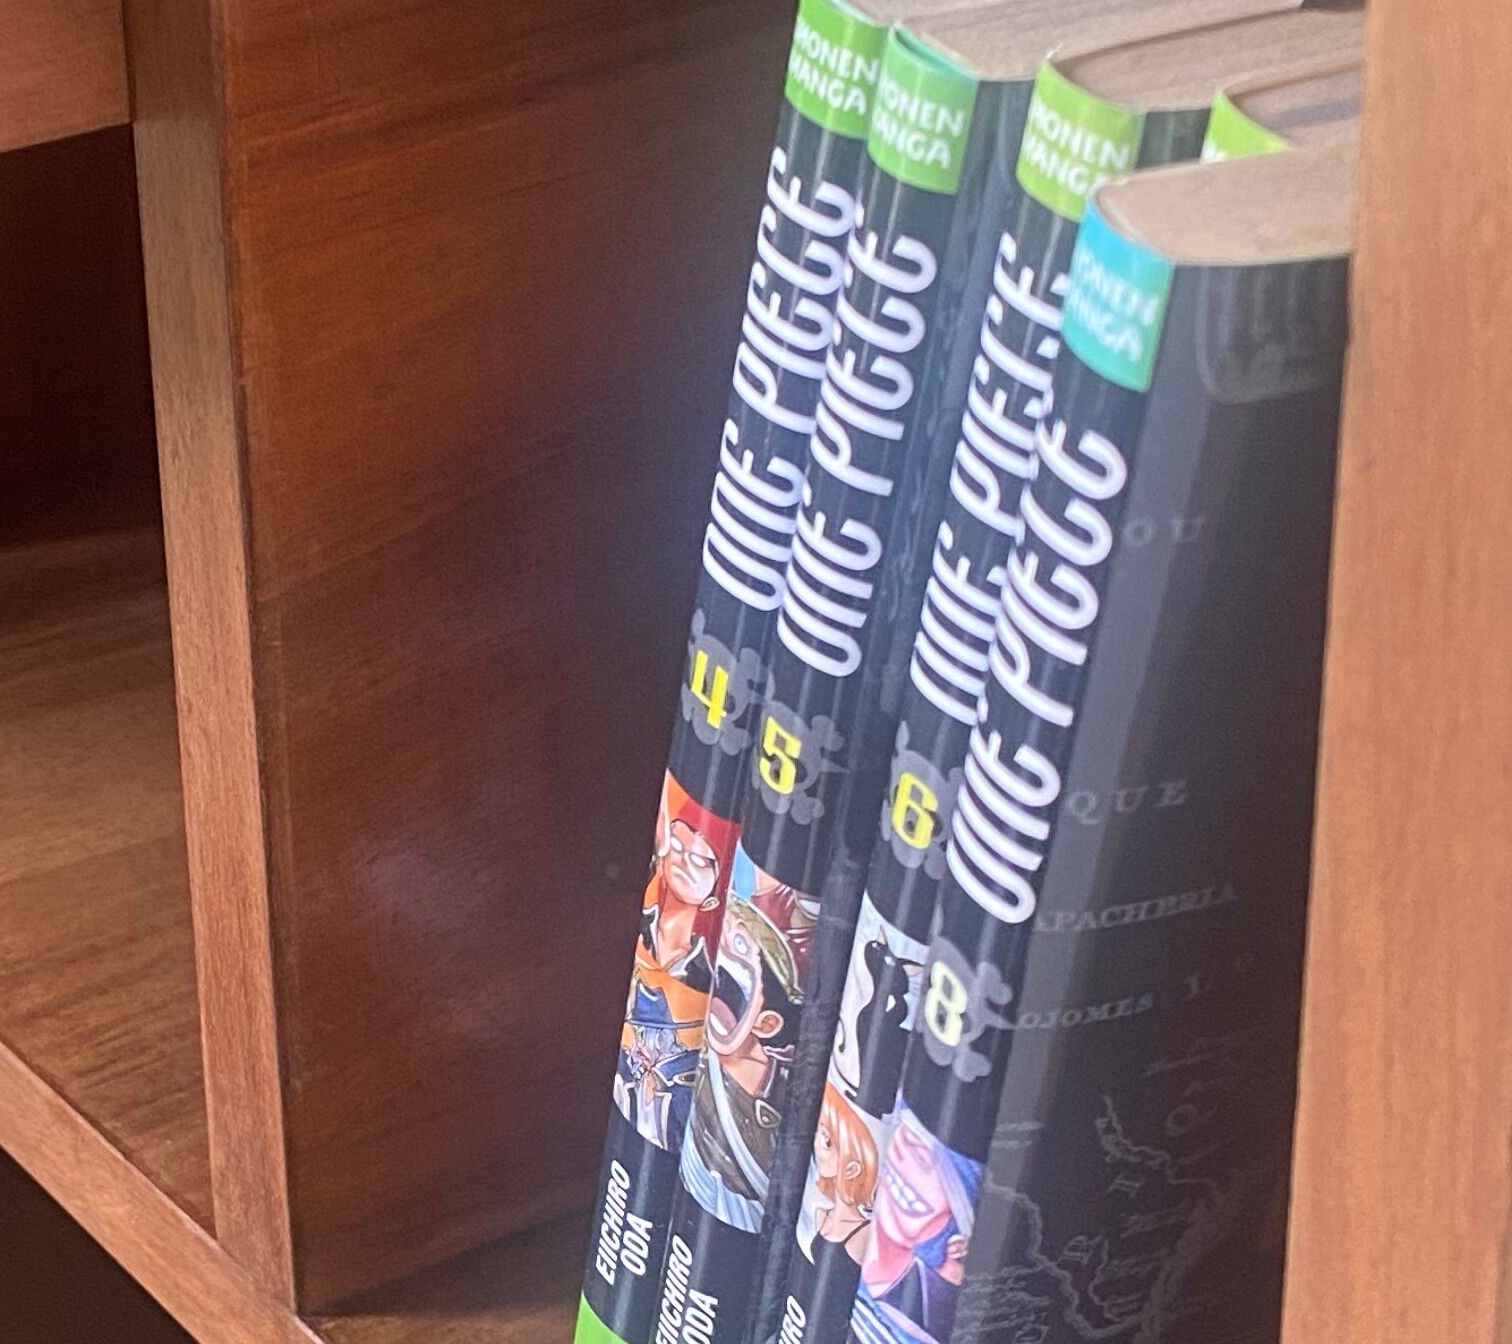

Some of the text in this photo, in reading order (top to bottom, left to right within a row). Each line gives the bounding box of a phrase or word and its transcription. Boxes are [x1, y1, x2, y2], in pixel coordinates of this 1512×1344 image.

[702, 146, 861, 611] ONE PIECE
[777, 201, 937, 677] ONE PIECE
[691, 649, 729, 729] 4
[947, 380, 1127, 924] ONE PIECE
[759, 716, 802, 795] 5
[891, 772, 939, 850] 6
[924, 961, 968, 1047] 8
[595, 1159, 631, 1286] EIICHIRO
[620, 1212, 653, 1276] ODA
